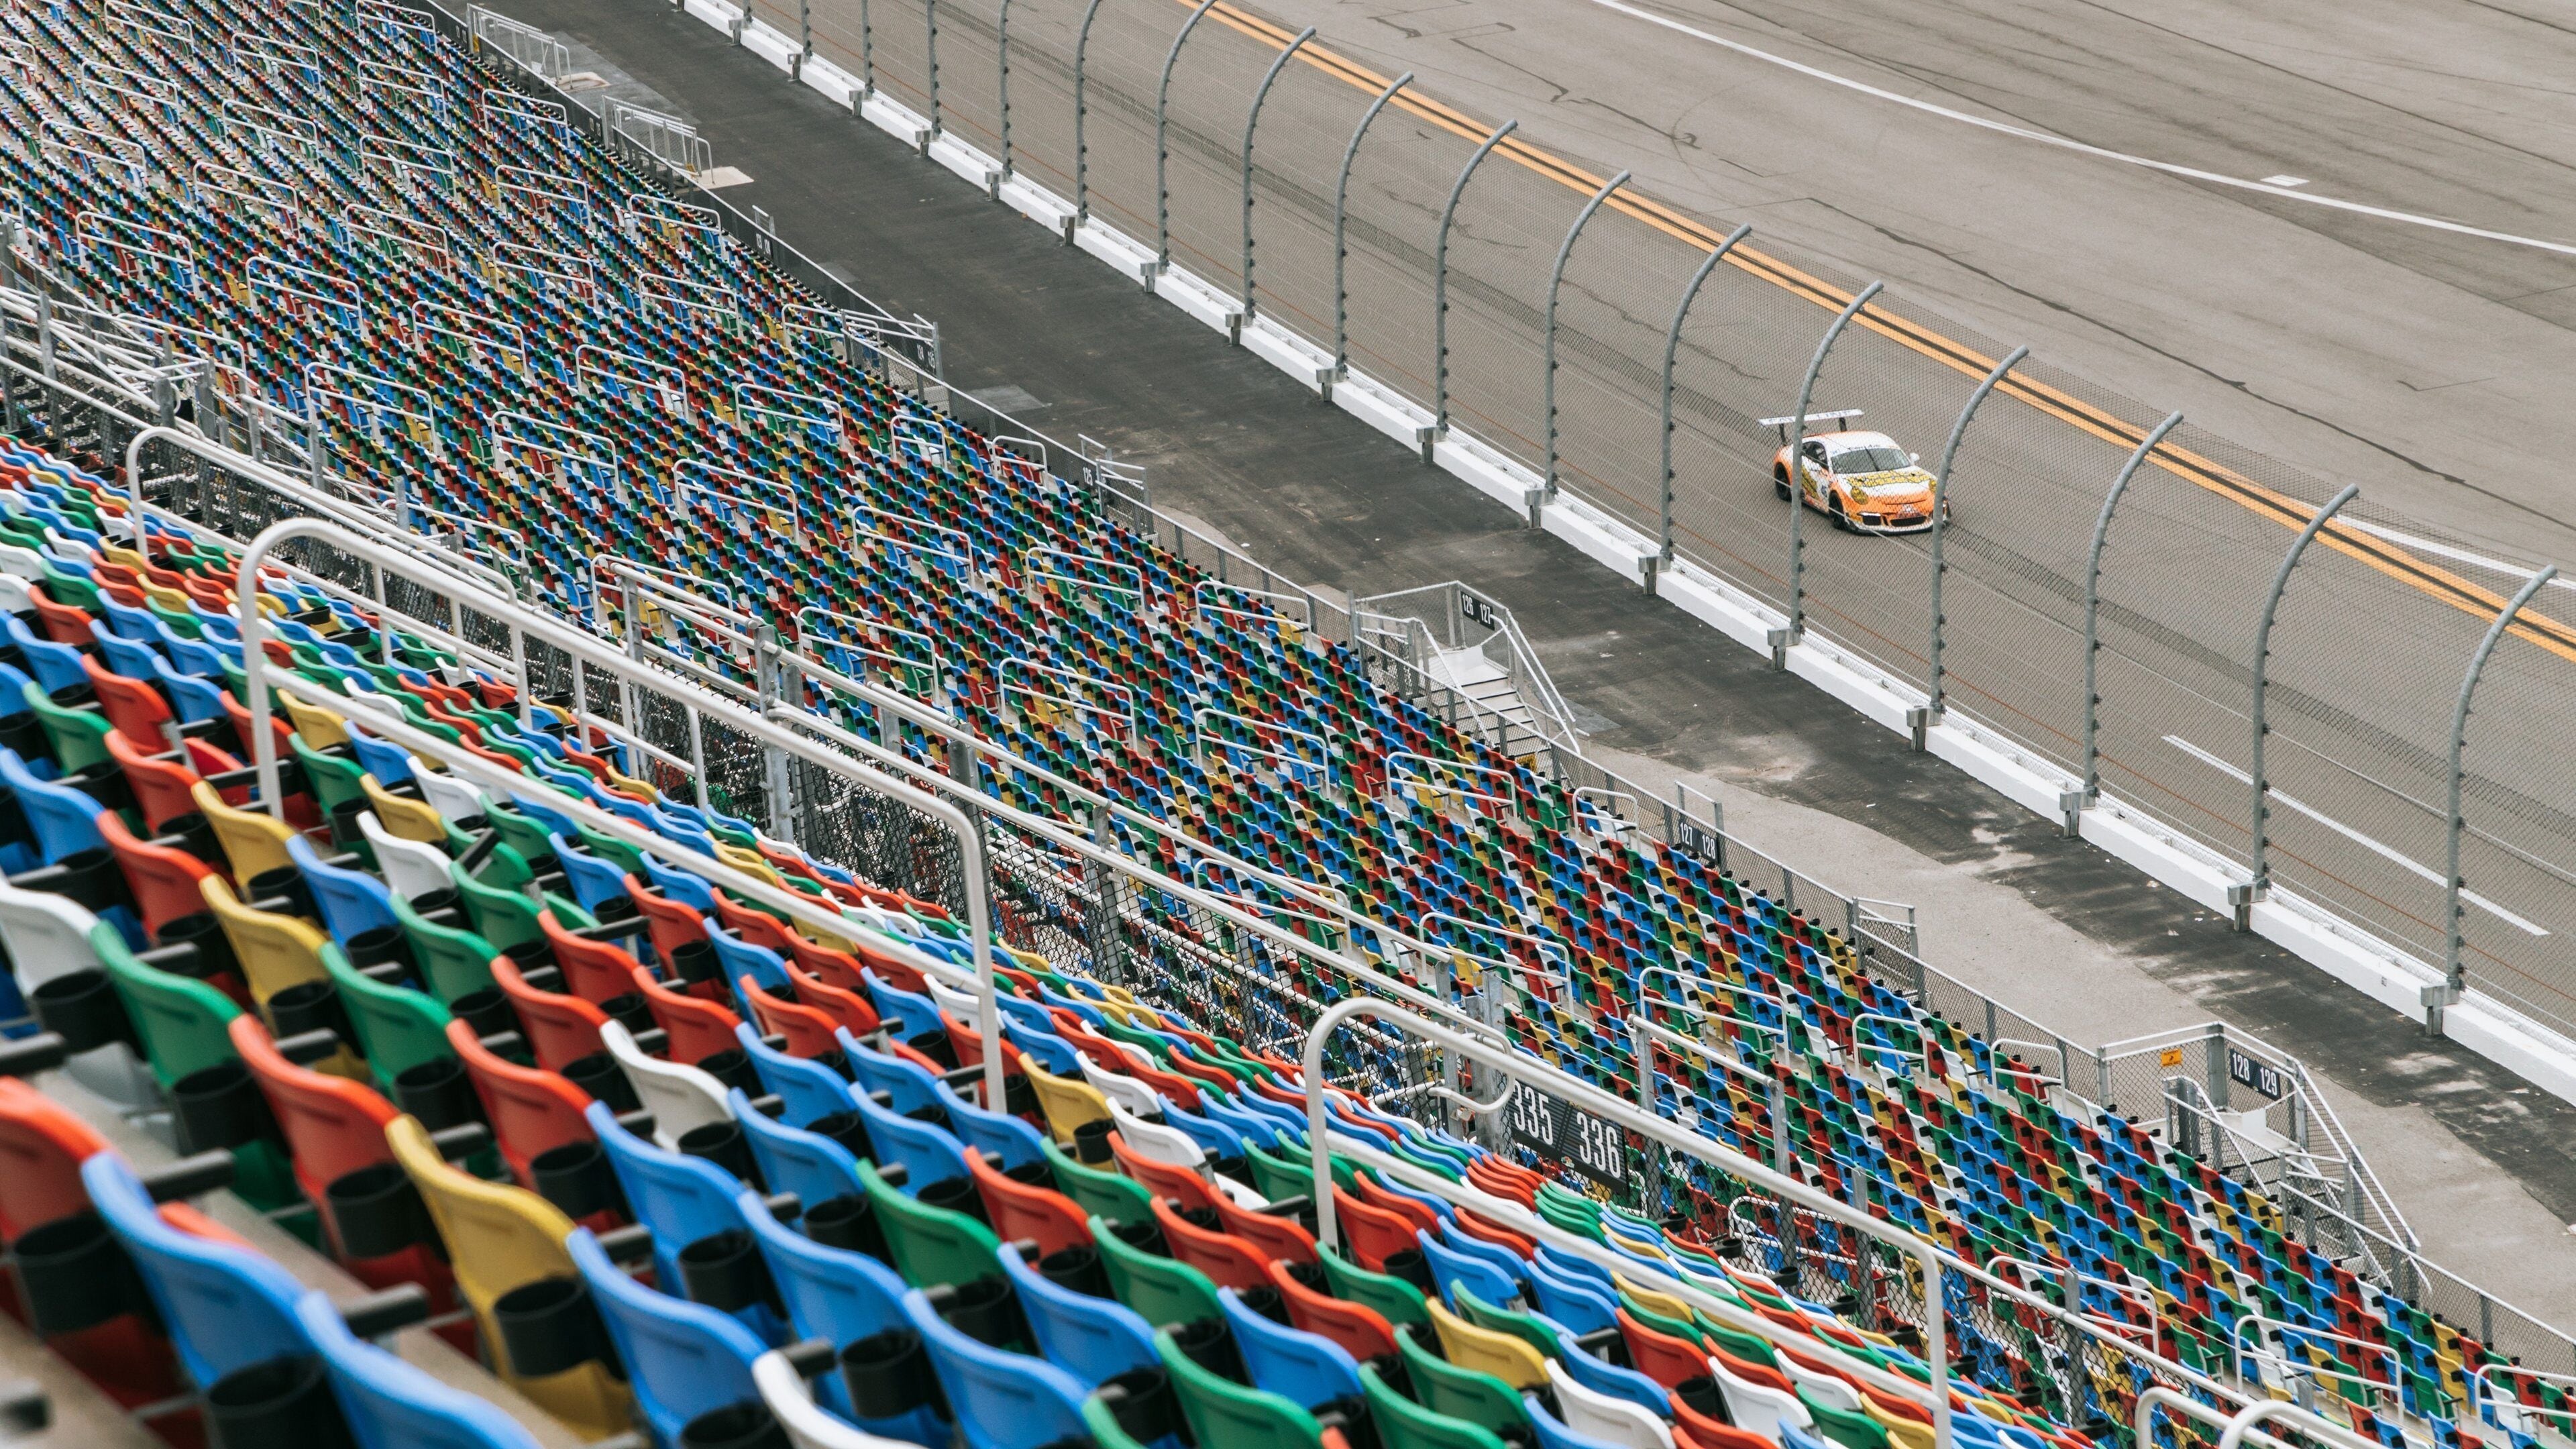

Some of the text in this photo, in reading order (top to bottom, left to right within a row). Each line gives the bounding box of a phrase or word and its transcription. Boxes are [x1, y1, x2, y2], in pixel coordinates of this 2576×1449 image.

[1083, 466, 1093, 486] 125
[1462, 594, 1491, 625] 126 127
[1680, 822, 1716, 859] 127 128
[2233, 1053, 2277, 1096] 128 129
[1513, 1080, 1621, 1179] 335 336
